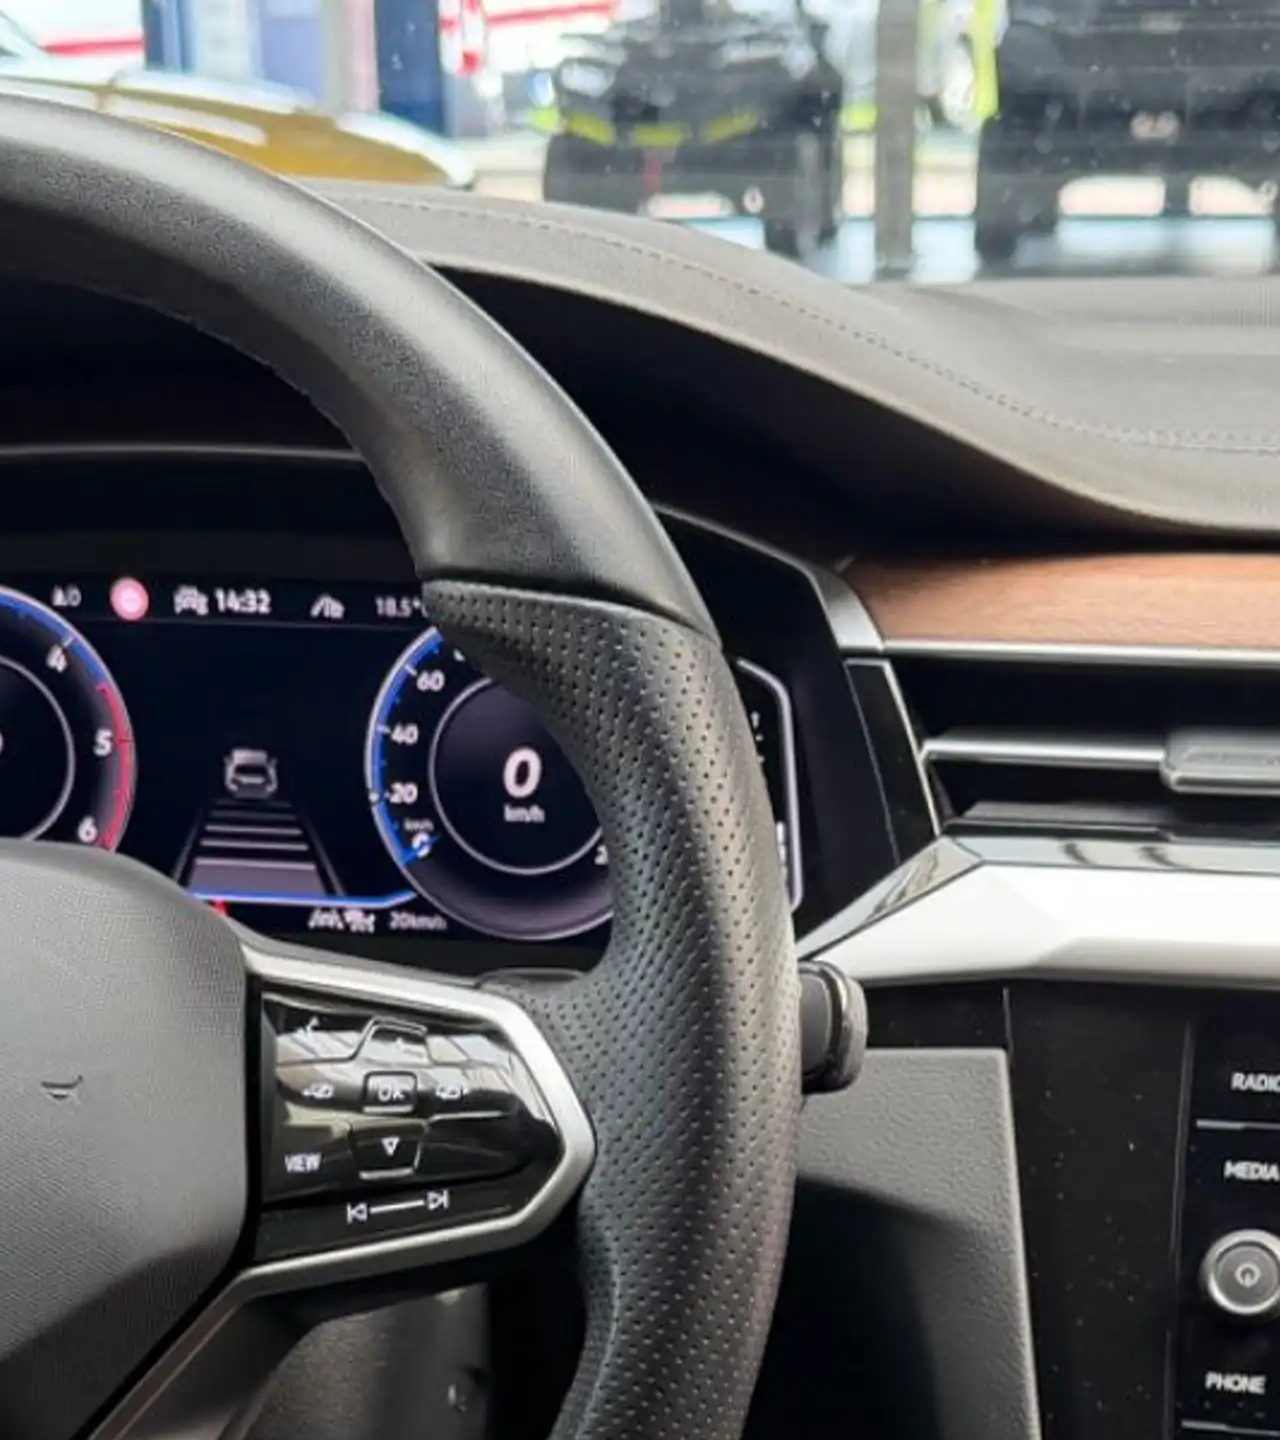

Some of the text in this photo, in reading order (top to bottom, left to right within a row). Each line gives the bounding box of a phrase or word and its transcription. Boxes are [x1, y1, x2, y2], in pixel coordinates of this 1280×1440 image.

[215, 587, 272, 614] 14:32
[376, 595, 428, 619] 18.5°
[46, 644, 69, 674] 4
[417, 669, 445, 693] 60
[94, 727, 113, 758] 5
[391, 724, 419, 746] 40
[503, 748, 543, 800] 0
[389, 782, 418, 805] 20
[503, 804, 545, 823] km/h
[77, 816, 97, 844] 6
[284, 1152, 322, 1174] VIEW
[1224, 1160, 1280, 1182] MEDIA
[1205, 1371, 1266, 1395] PHONE
